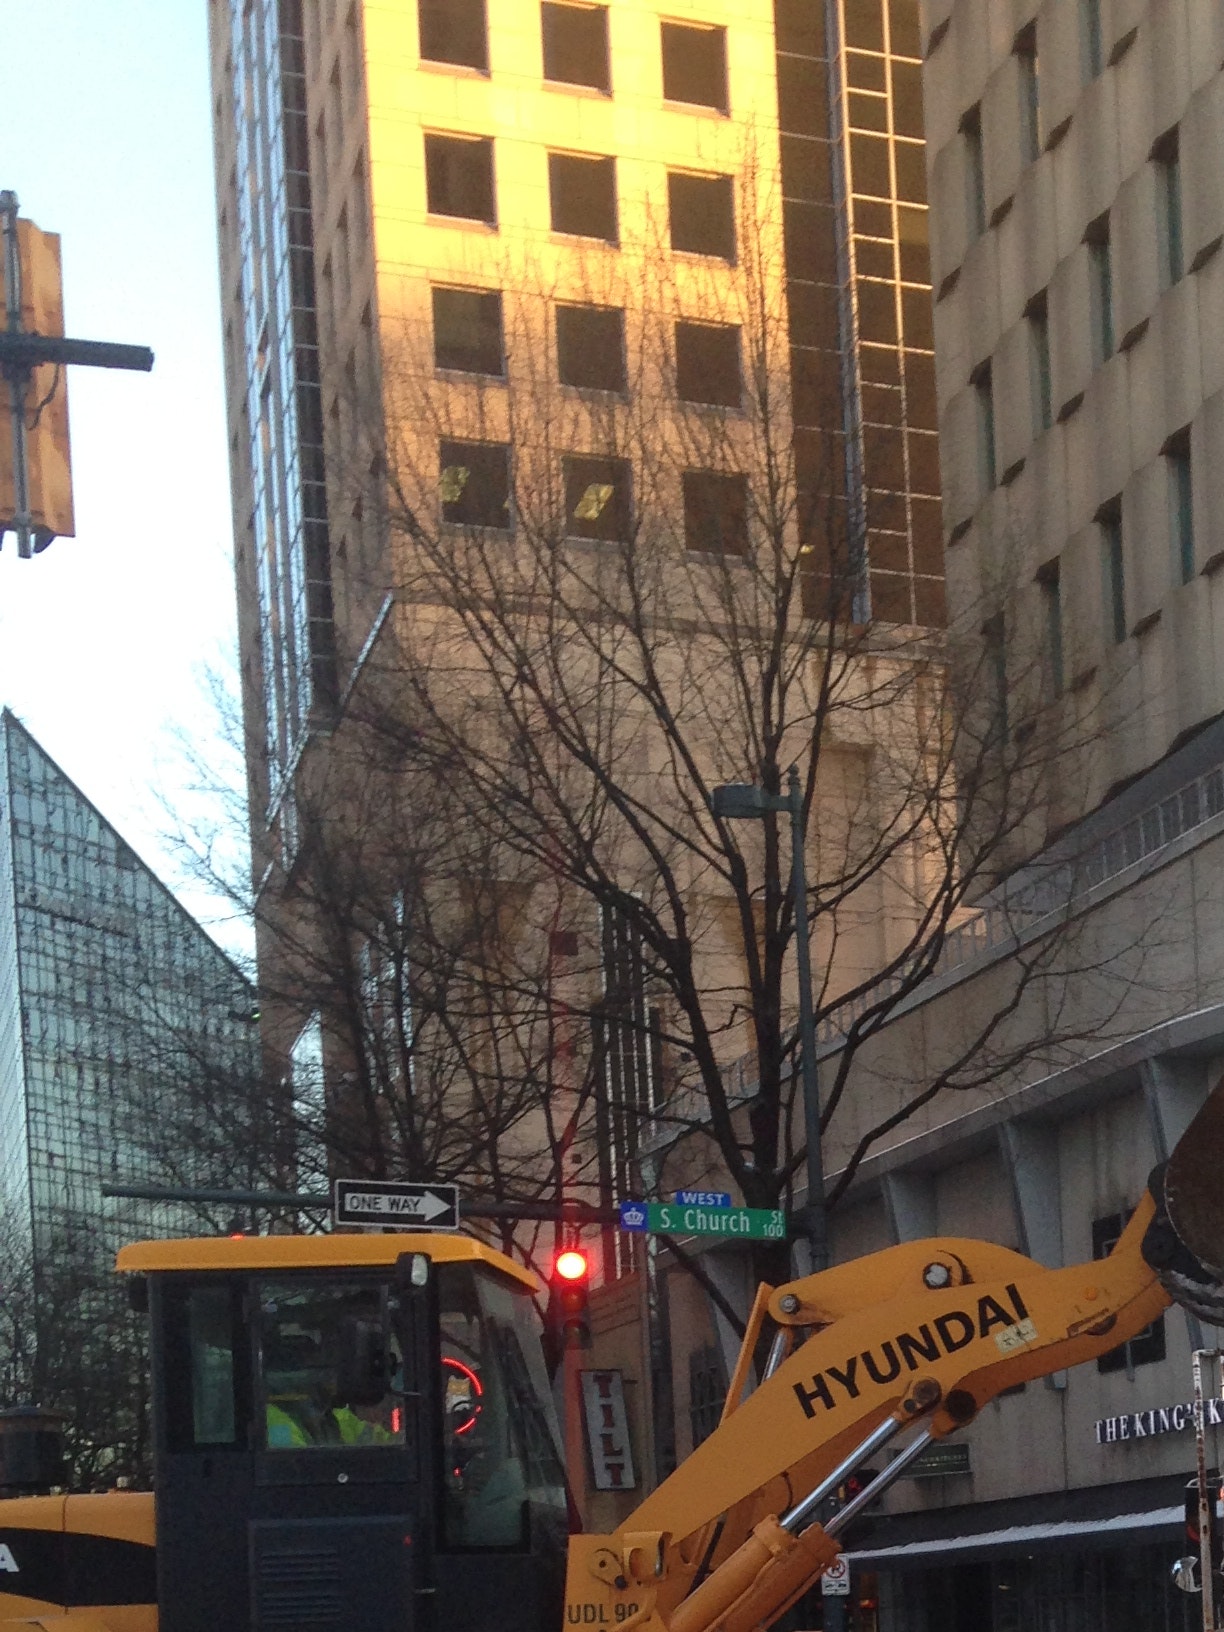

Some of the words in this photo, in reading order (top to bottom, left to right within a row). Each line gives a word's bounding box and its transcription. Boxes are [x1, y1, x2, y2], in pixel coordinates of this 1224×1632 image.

[349, 1195, 382, 1211] ONE
[388, 1197, 421, 1213] WAY
[682, 1192, 724, 1206] WEST
[660, 1208, 676, 1229] S.
[684, 1209, 751, 1233] Church
[770, 1211, 783, 1224] St
[762, 1224, 784, 1238] 100
[792, 1283, 1030, 1420] HYUNDAI
[592, 1373, 625, 1487] TILT
[1094, 1415, 1131, 1444] THE
[567, 1603, 609, 1625] UDL
